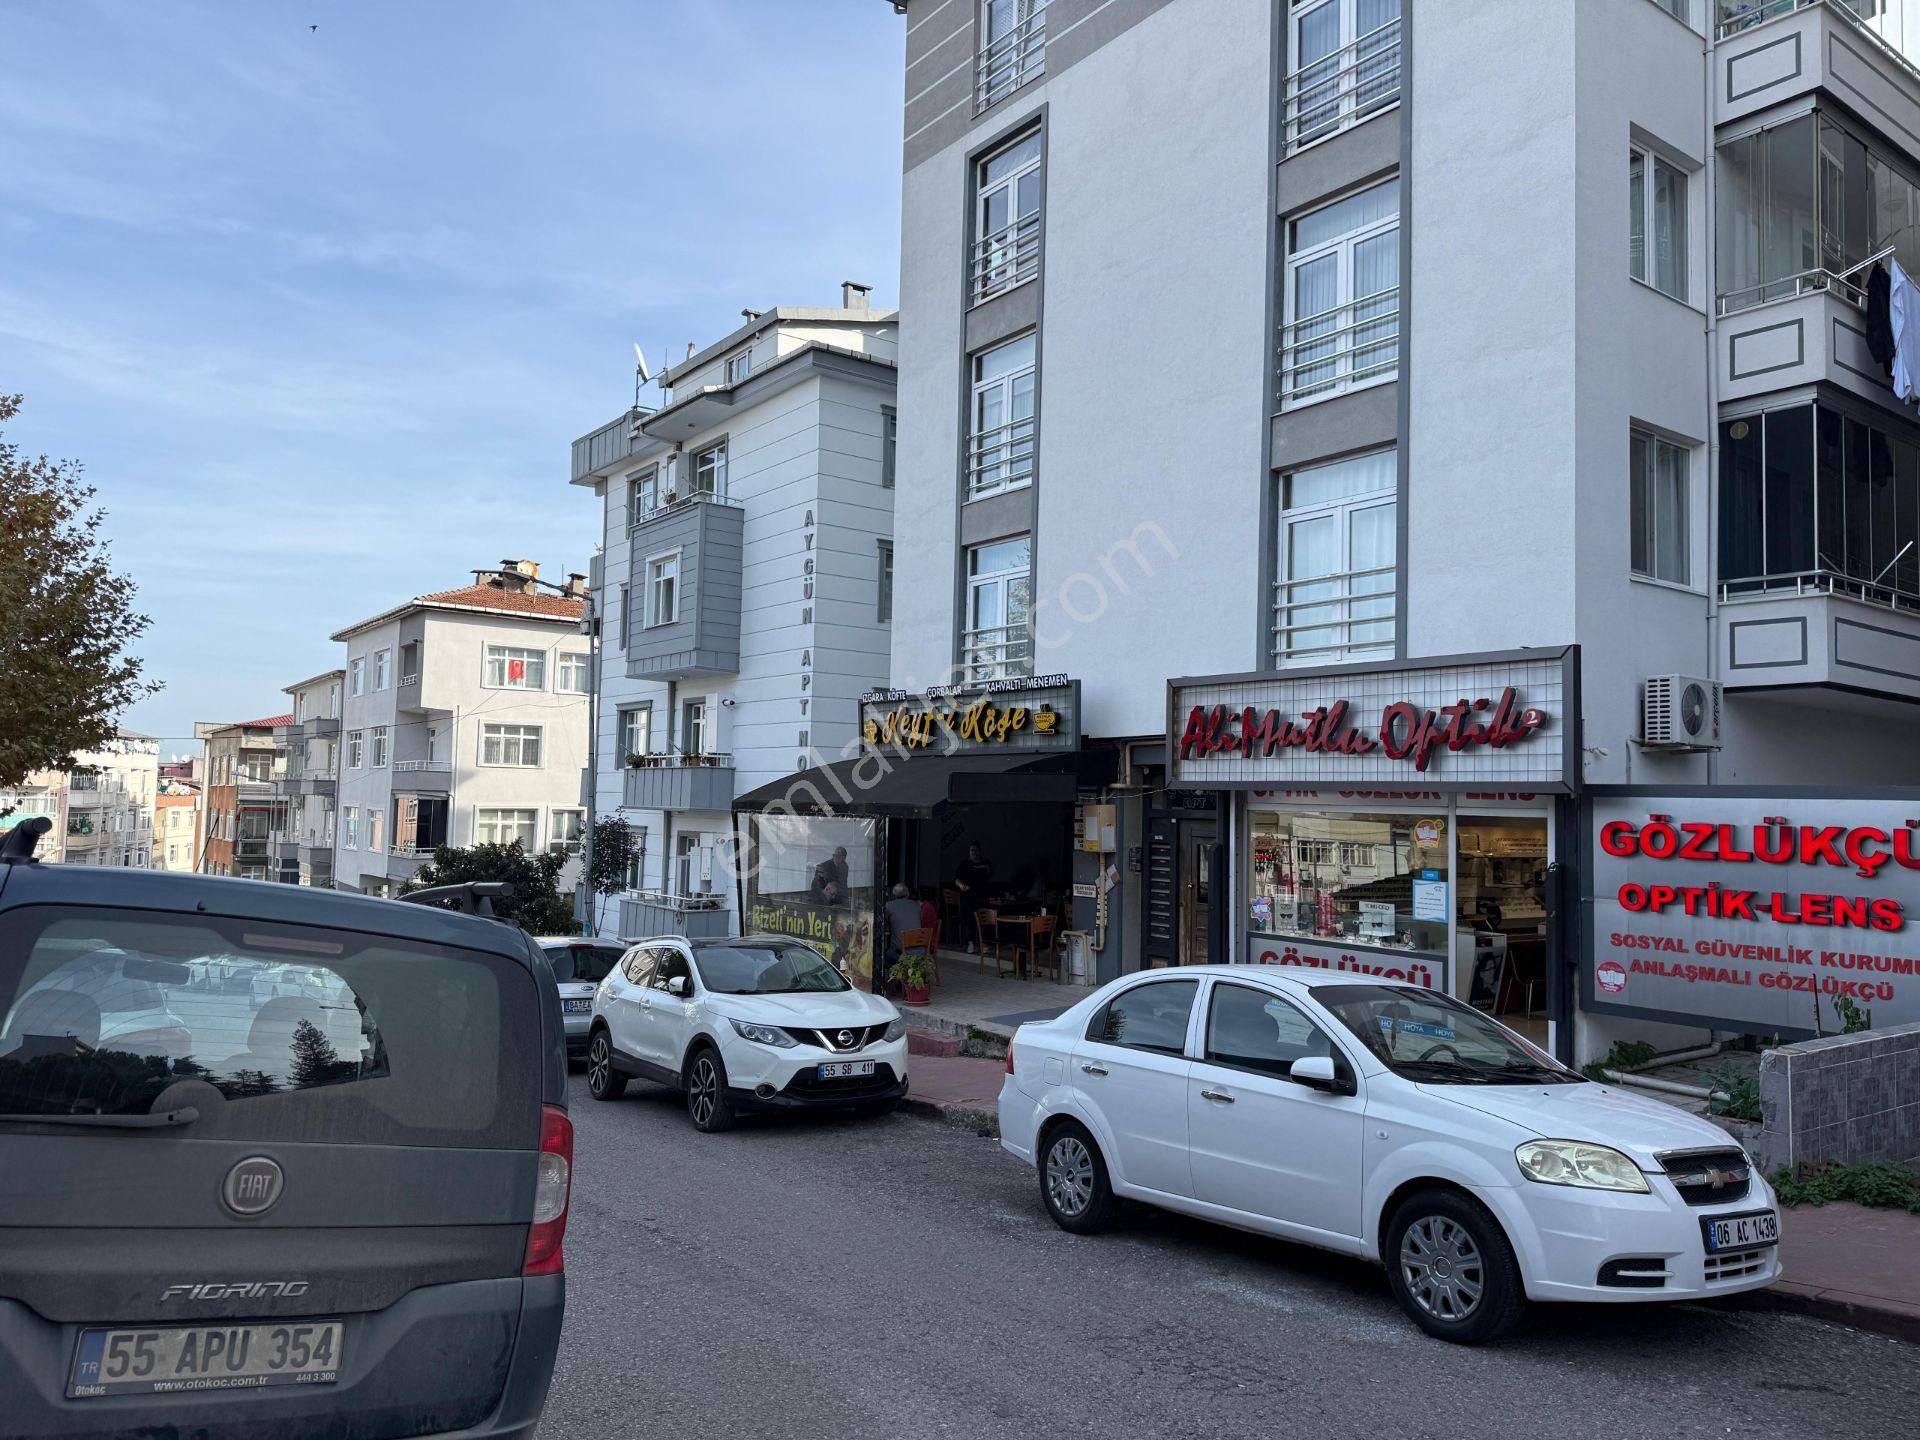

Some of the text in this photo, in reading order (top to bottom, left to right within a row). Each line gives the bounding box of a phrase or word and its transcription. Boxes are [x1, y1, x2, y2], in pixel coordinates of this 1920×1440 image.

[797, 509, 815, 772] AYGÜN APT NO
[887, 688, 907, 701] KÖFTE
[927, 685, 962, 700] ÇORBALAR
[960, 702, 1027, 743] Köşe
[1180, 702, 1242, 761] Ali
[1241, 698, 1378, 760] Mutlu
[1378, 685, 1532, 773] Optik
[807, 911, 832, 940] Yeri
[1610, 933, 1690, 954] SOSYAL
[1695, 939, 1814, 966] GÜVENLİK
[1630, 958, 1751, 986] ANLAŞMALI
[1759, 972, 1894, 1002] GÖZLÜKÇÜ
[1405, 1023, 1424, 1034] HOYA
[1435, 1027, 1456, 1039] HOYA
[825, 1062, 874, 1076] 55 SB 411
[239, 1174, 272, 1199] FIAT
[1717, 1216, 1777, 1246] 06 AC 1438
[160, 1281, 310, 1301] FIORINO
[106, 1326, 333, 1378] 55 APU 354
[81, 1361, 98, 1374] TR
[320, 1371, 336, 1381] 300
[153, 1374, 269, 1392] www.otokoc.com.tr
